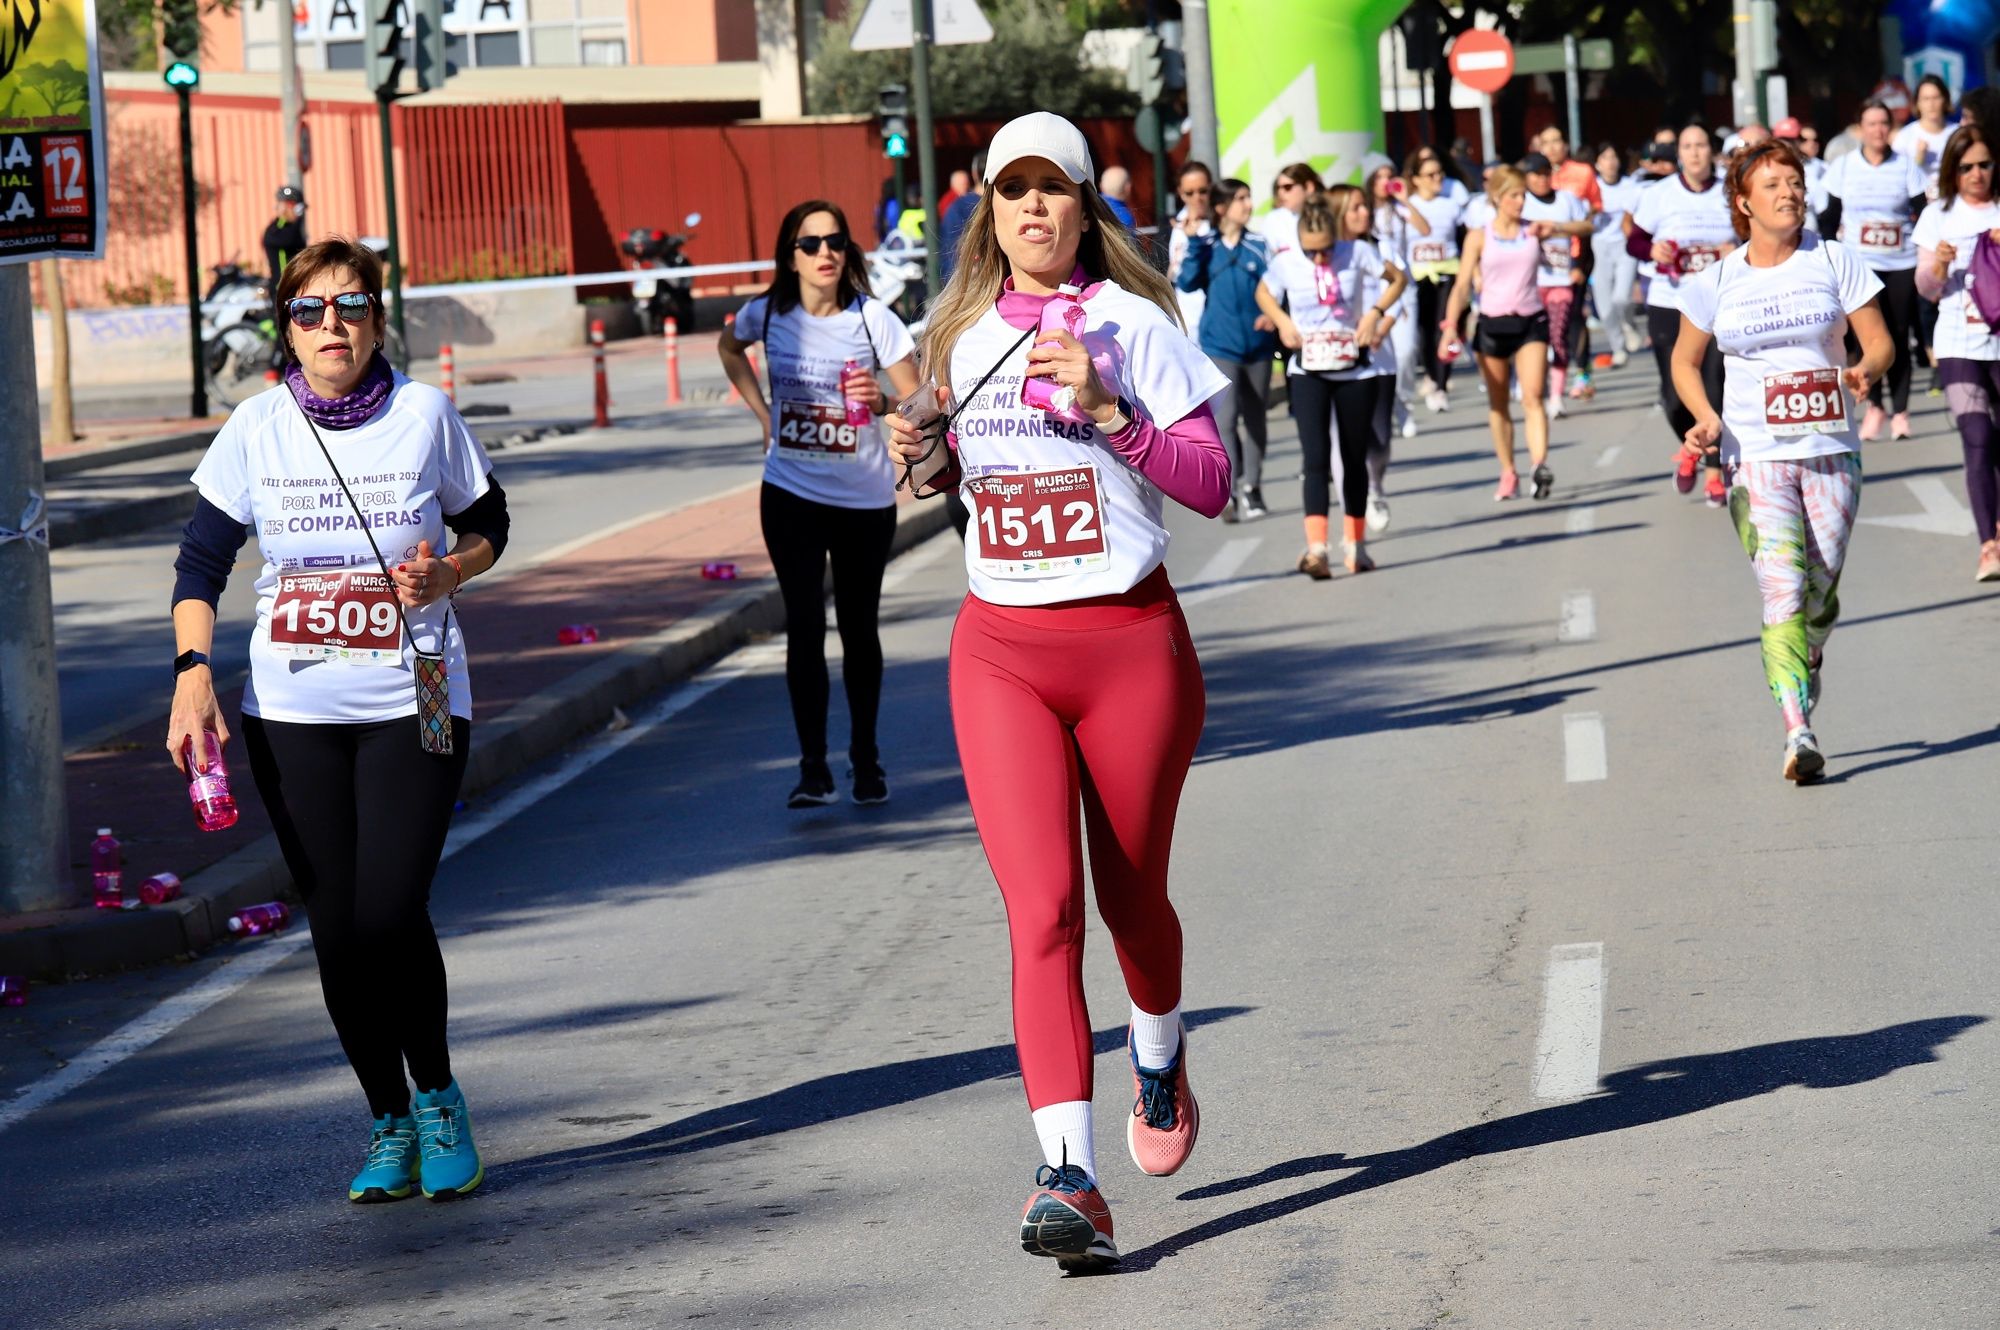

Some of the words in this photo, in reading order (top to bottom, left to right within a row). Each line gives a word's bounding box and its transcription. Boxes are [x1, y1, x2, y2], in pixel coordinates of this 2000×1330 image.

[0, 136, 32, 170] A
[44, 146, 84, 201] 12
[51, 205, 82, 214] MARZO
[1763, 302, 1781, 317] MÍ
[1743, 311, 1837, 335] COMPAÑERAS
[1007, 375, 1021, 385] DE
[965, 394, 990, 411] OR
[992, 385, 1016, 409] MÍ
[1767, 389, 1841, 419] 4991
[781, 419, 856, 446] 4206
[966, 413, 1094, 440] COMPAÑERAS
[261, 477, 280, 487] VIII
[282, 478, 328, 488] CARRERA
[347, 477, 360, 486] LA
[363, 473, 396, 484] MUJER
[399, 471, 421, 481] 2023
[1034, 472, 1089, 488] MURCIA
[1050, 485, 1074, 493] MARZO
[1075, 483, 1091, 491] 2023
[282, 495, 316, 510] POR
[319, 487, 344, 508] MÍ
[362, 490, 397, 507] POR
[990, 483, 1024, 503] mujer
[288, 509, 422, 533] COMPAÑERAS
[980, 500, 1098, 547] 1512
[1022, 549, 1043, 558] CRIS
[297, 576, 322, 584] carrera
[303, 580, 341, 598] mujer
[278, 598, 398, 638] 1509
